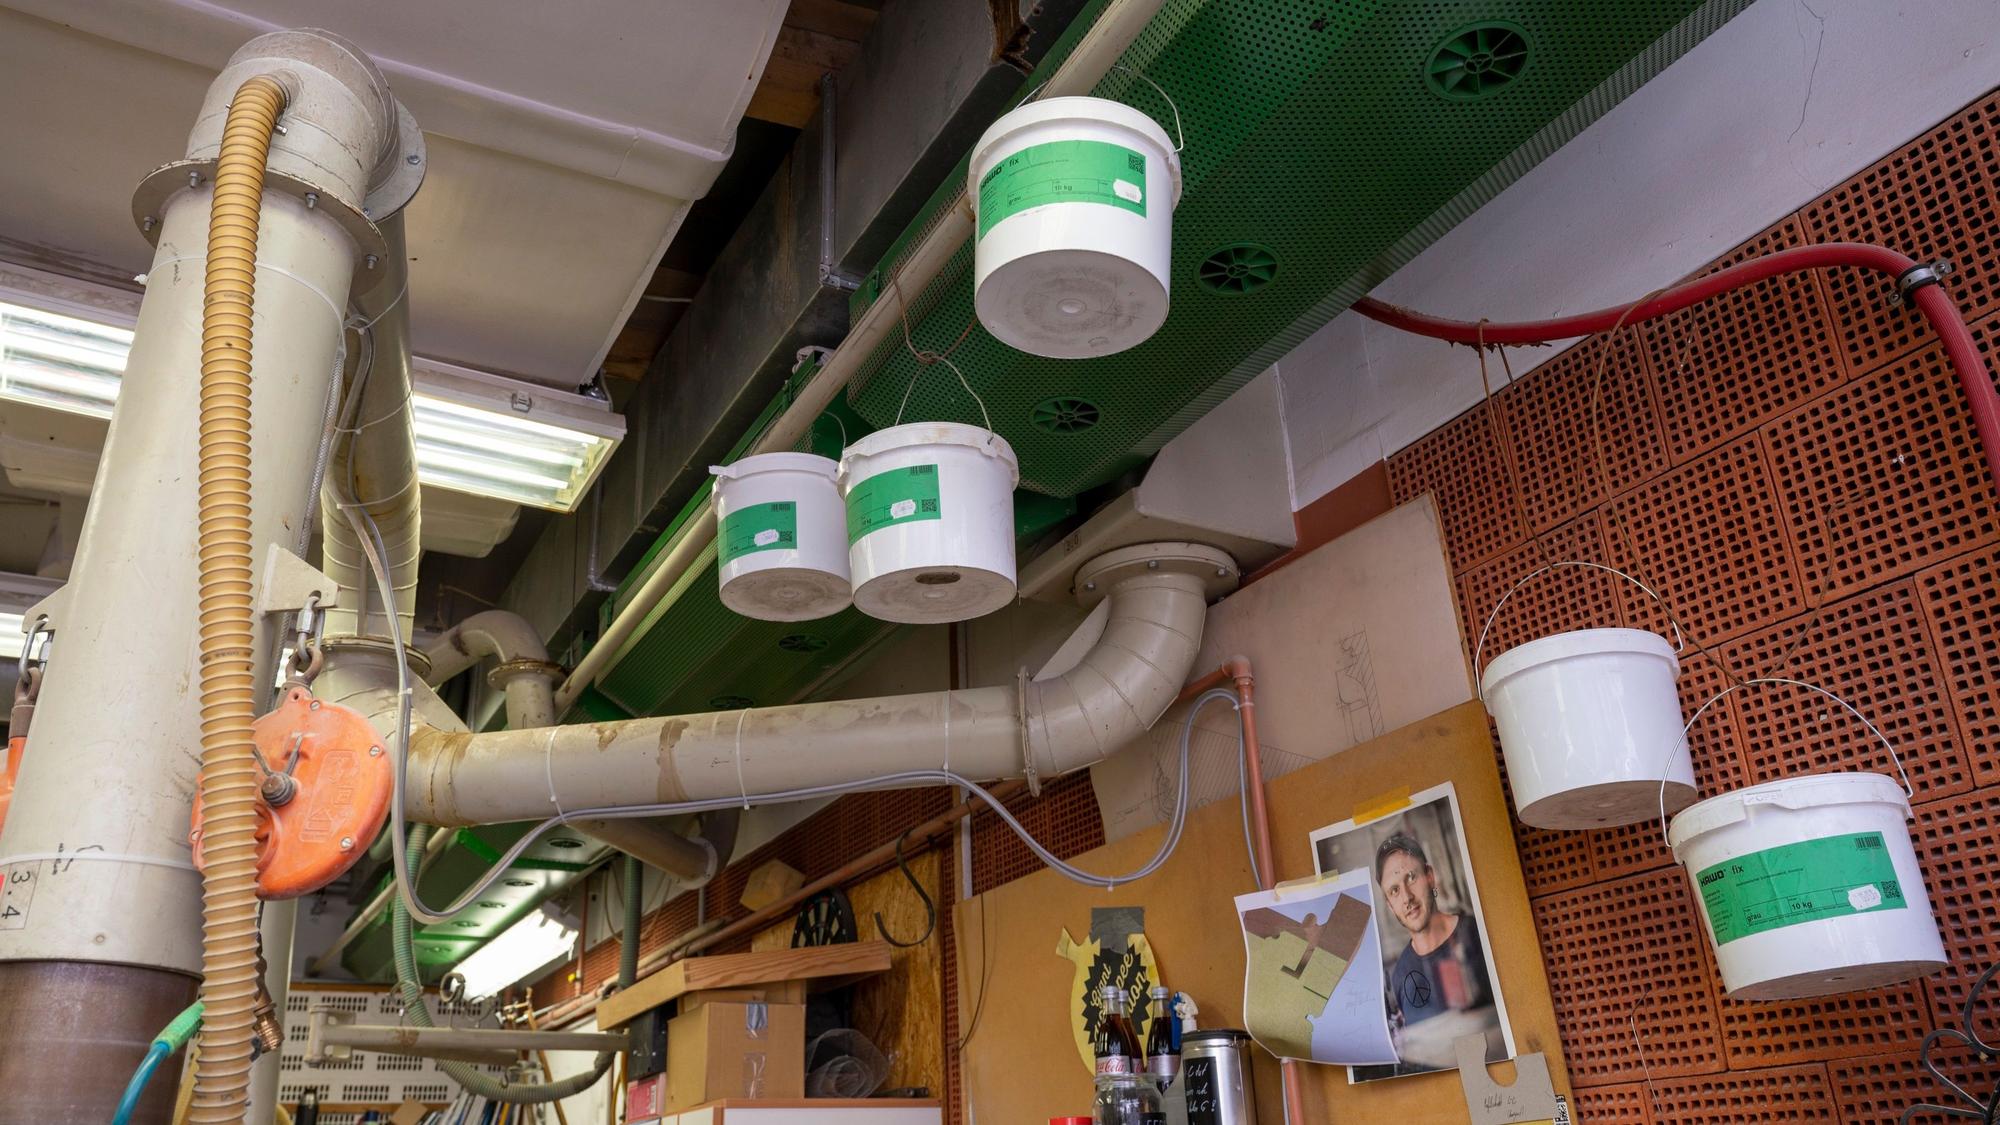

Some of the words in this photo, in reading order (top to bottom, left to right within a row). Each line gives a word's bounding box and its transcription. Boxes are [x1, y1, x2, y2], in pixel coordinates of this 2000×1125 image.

[1009, 158, 1019, 167] fix
[1732, 865, 1744, 875] fix
[1792, 903, 1801, 911] 10
[1803, 901, 1813, 910] kg
[1746, 913, 1762, 924] grau
[1090, 963, 1112, 1008] Giant
